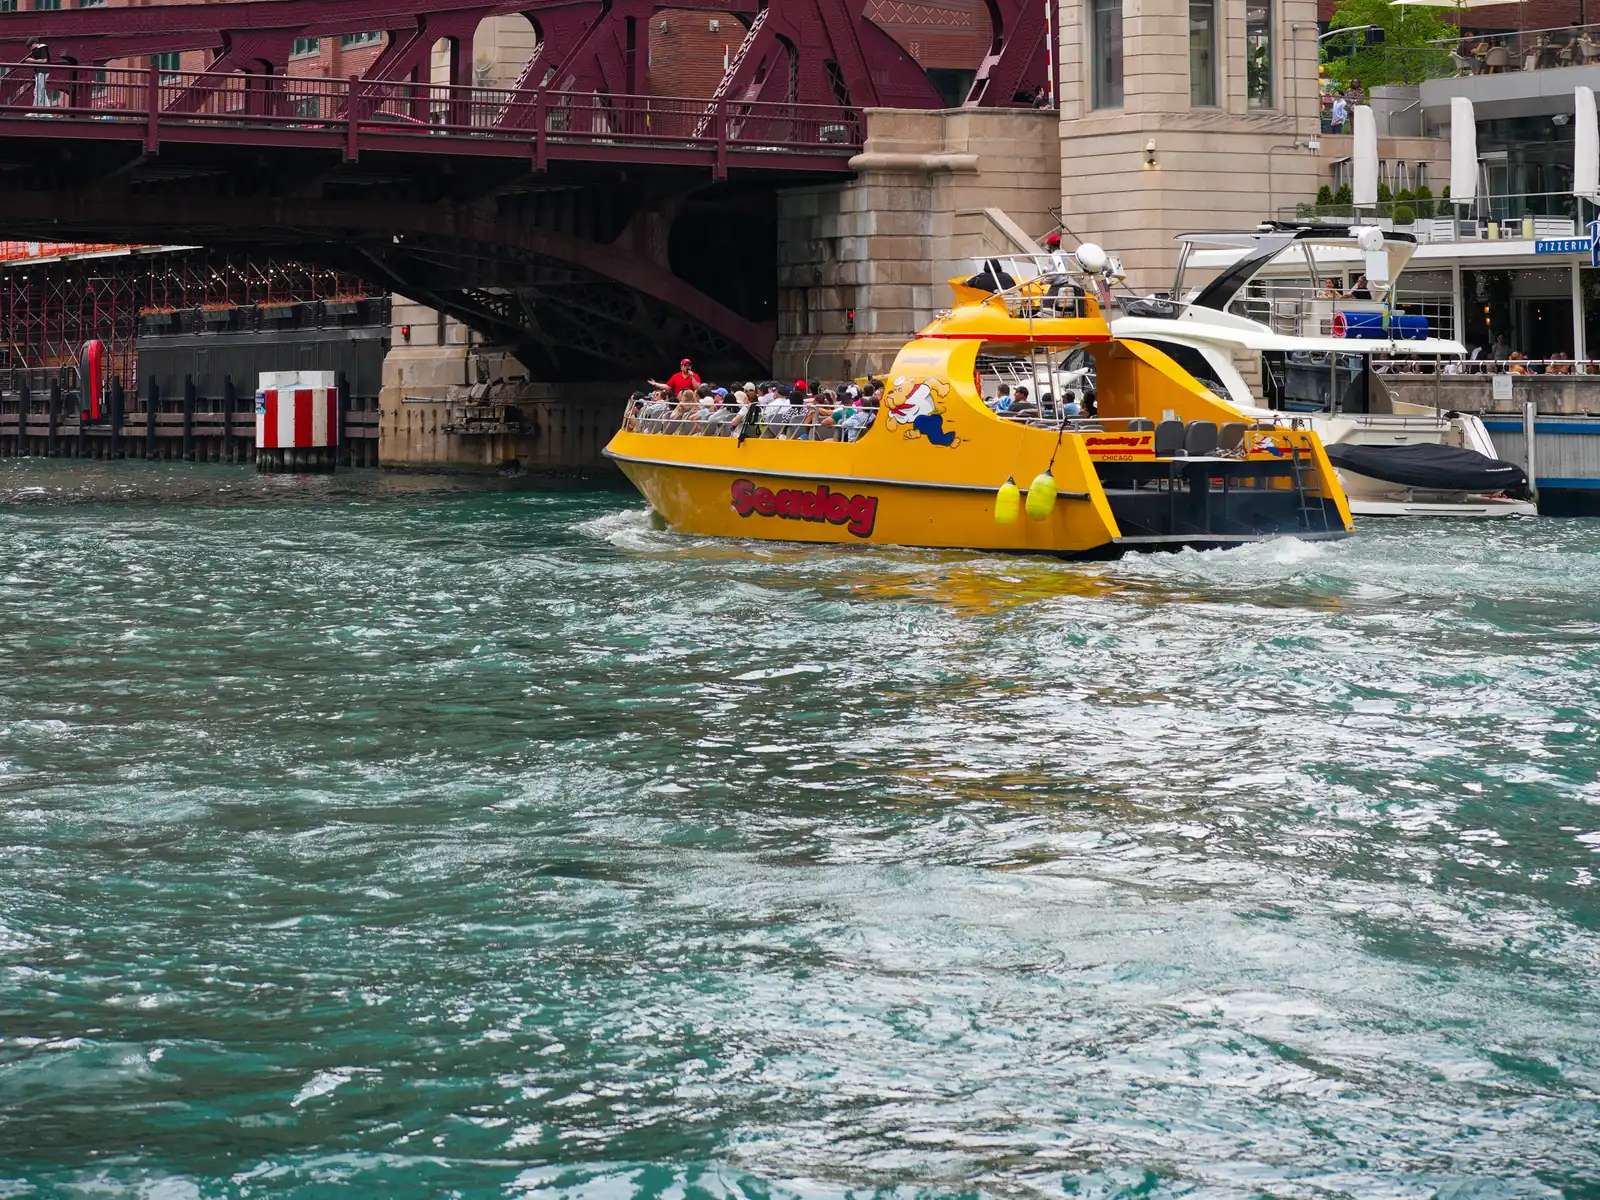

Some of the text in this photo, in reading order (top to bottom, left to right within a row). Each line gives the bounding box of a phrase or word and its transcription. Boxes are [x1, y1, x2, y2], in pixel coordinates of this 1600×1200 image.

[1538, 241, 1589, 252] PIZZERIA
[1102, 454, 1133, 462] CHICAGO
[730, 478, 879, 539] Seadog
